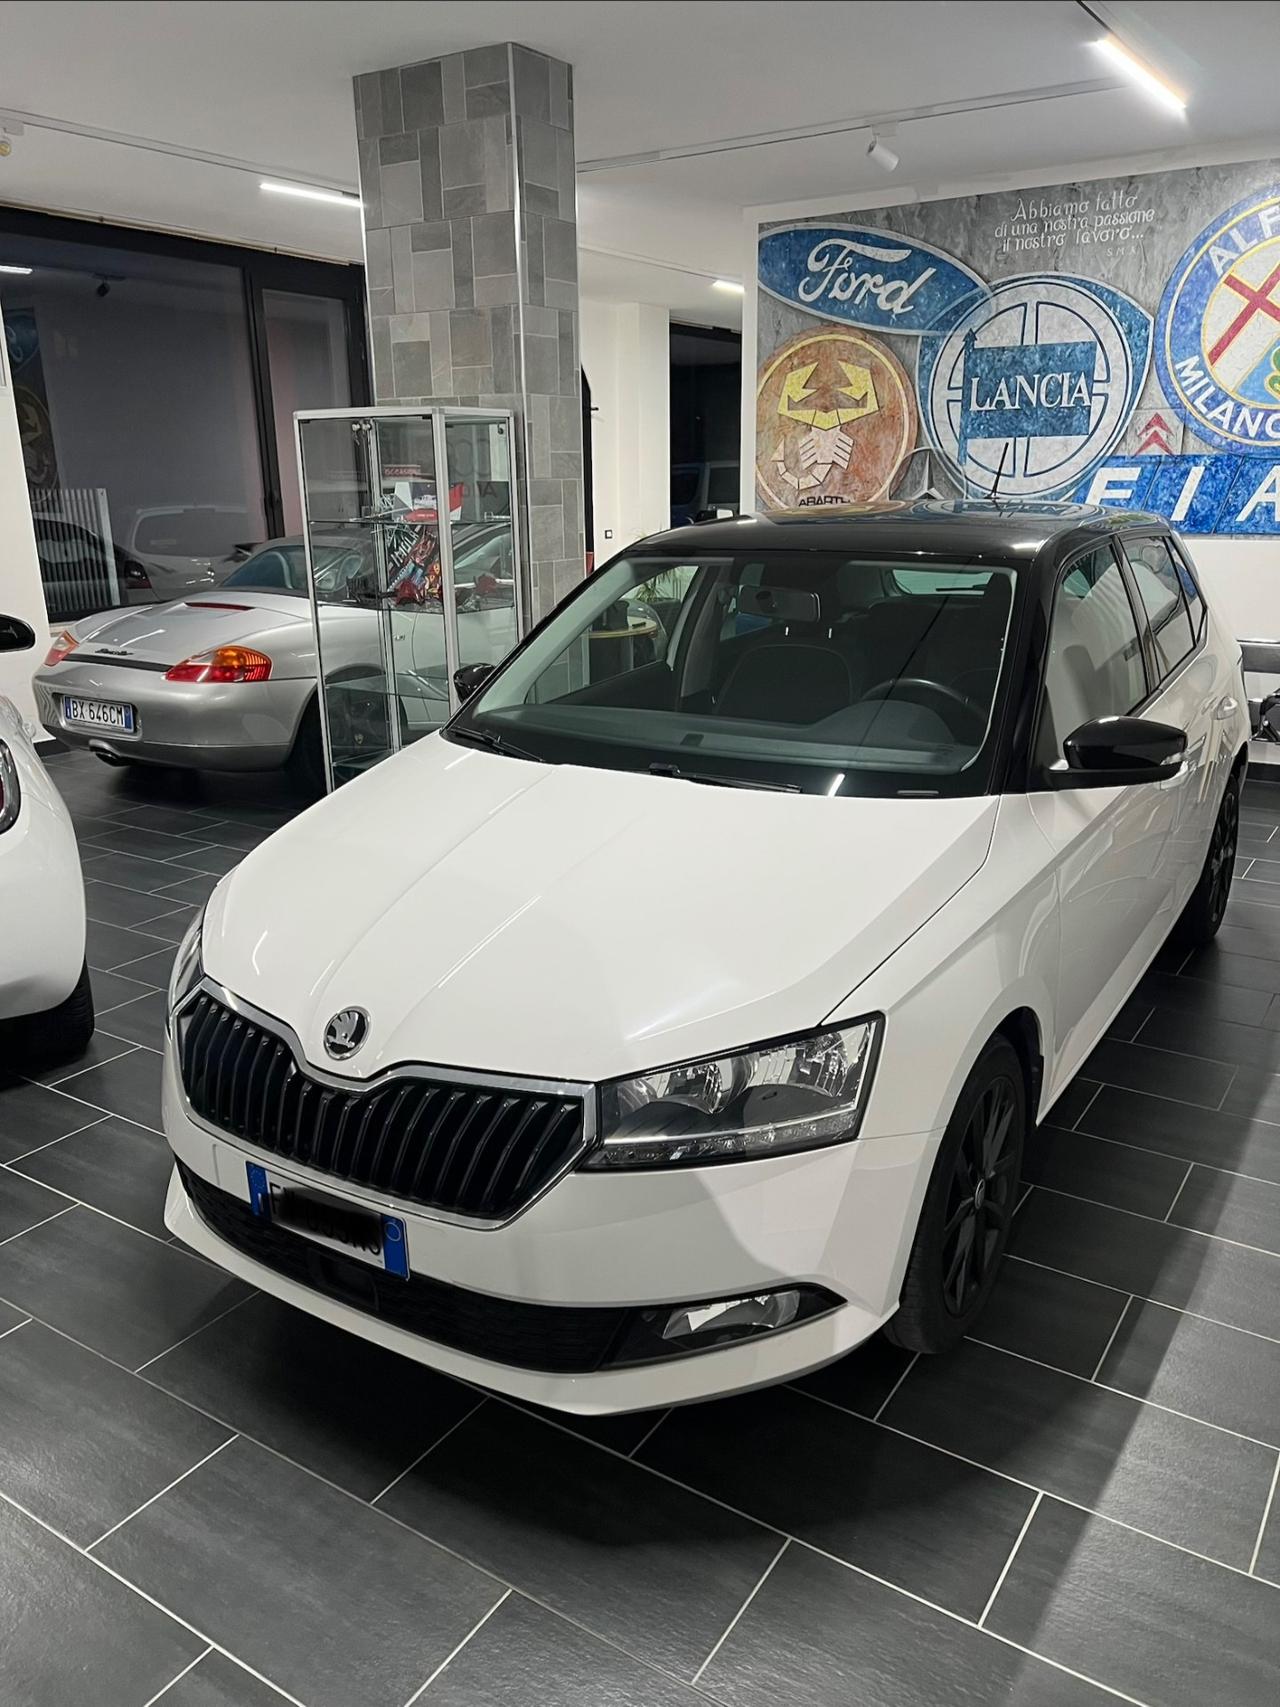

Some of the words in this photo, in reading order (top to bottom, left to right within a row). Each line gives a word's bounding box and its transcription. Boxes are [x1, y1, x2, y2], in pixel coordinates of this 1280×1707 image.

[994, 222, 1008, 239] di
[1011, 222, 1038, 237] una
[1043, 214, 1089, 234] nostra
[1094, 208, 1155, 230] passione
[1010, 198, 1090, 222] Abbiamo
[1002, 237, 1010, 253] il
[1015, 232, 1066, 252] nostro
[797, 238, 937, 315] Ford
[967, 372, 1093, 413] LANCIA
[72, 700, 85, 720] BX
[88, 703, 124, 726] 646CM
